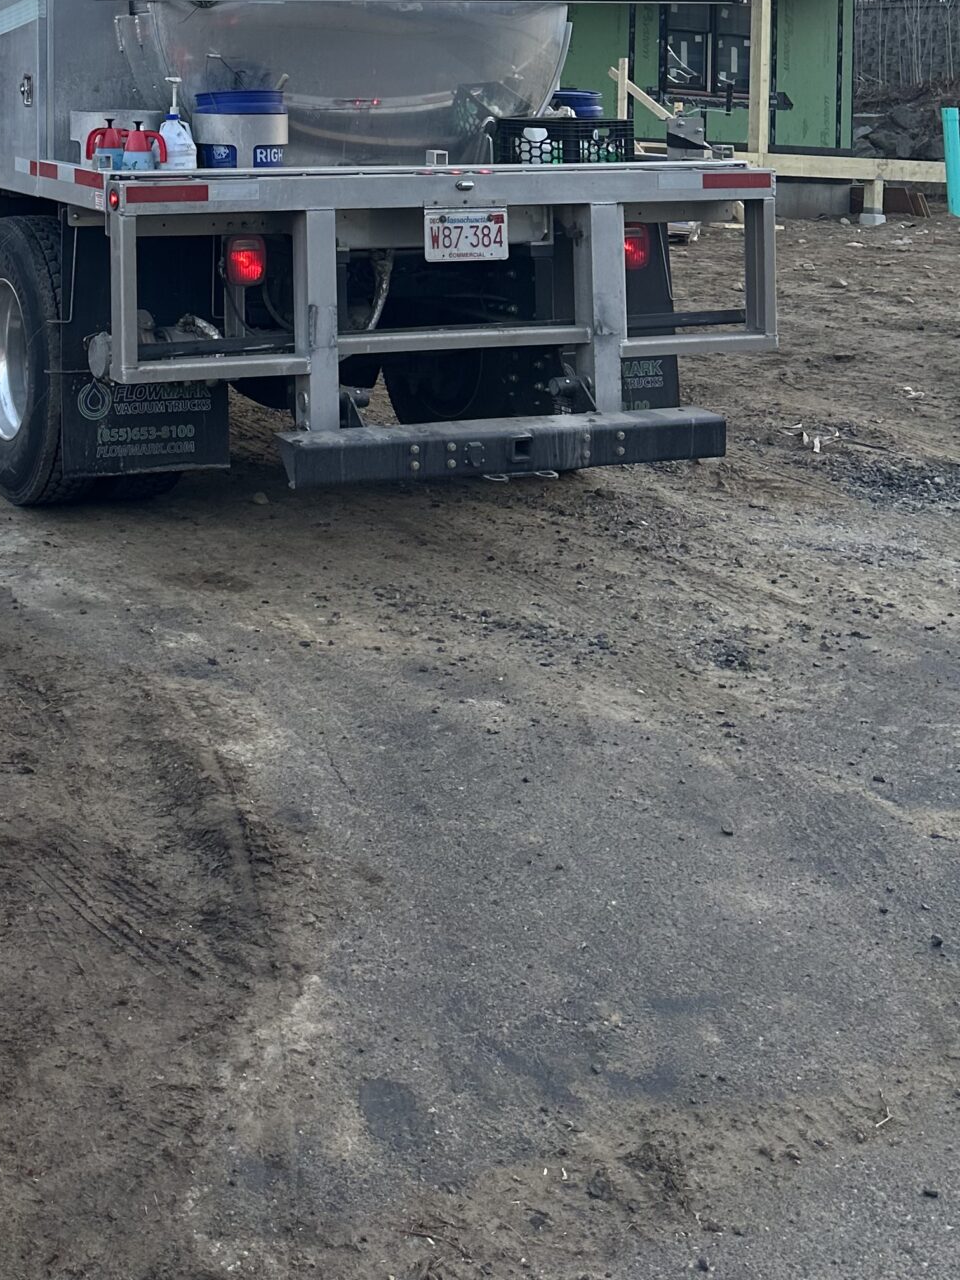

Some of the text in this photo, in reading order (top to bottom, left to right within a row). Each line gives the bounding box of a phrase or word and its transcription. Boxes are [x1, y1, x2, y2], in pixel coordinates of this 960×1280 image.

[113, 383, 212, 402] FLOWMARK
[113, 399, 212, 415] VACUUM TRUCKS
